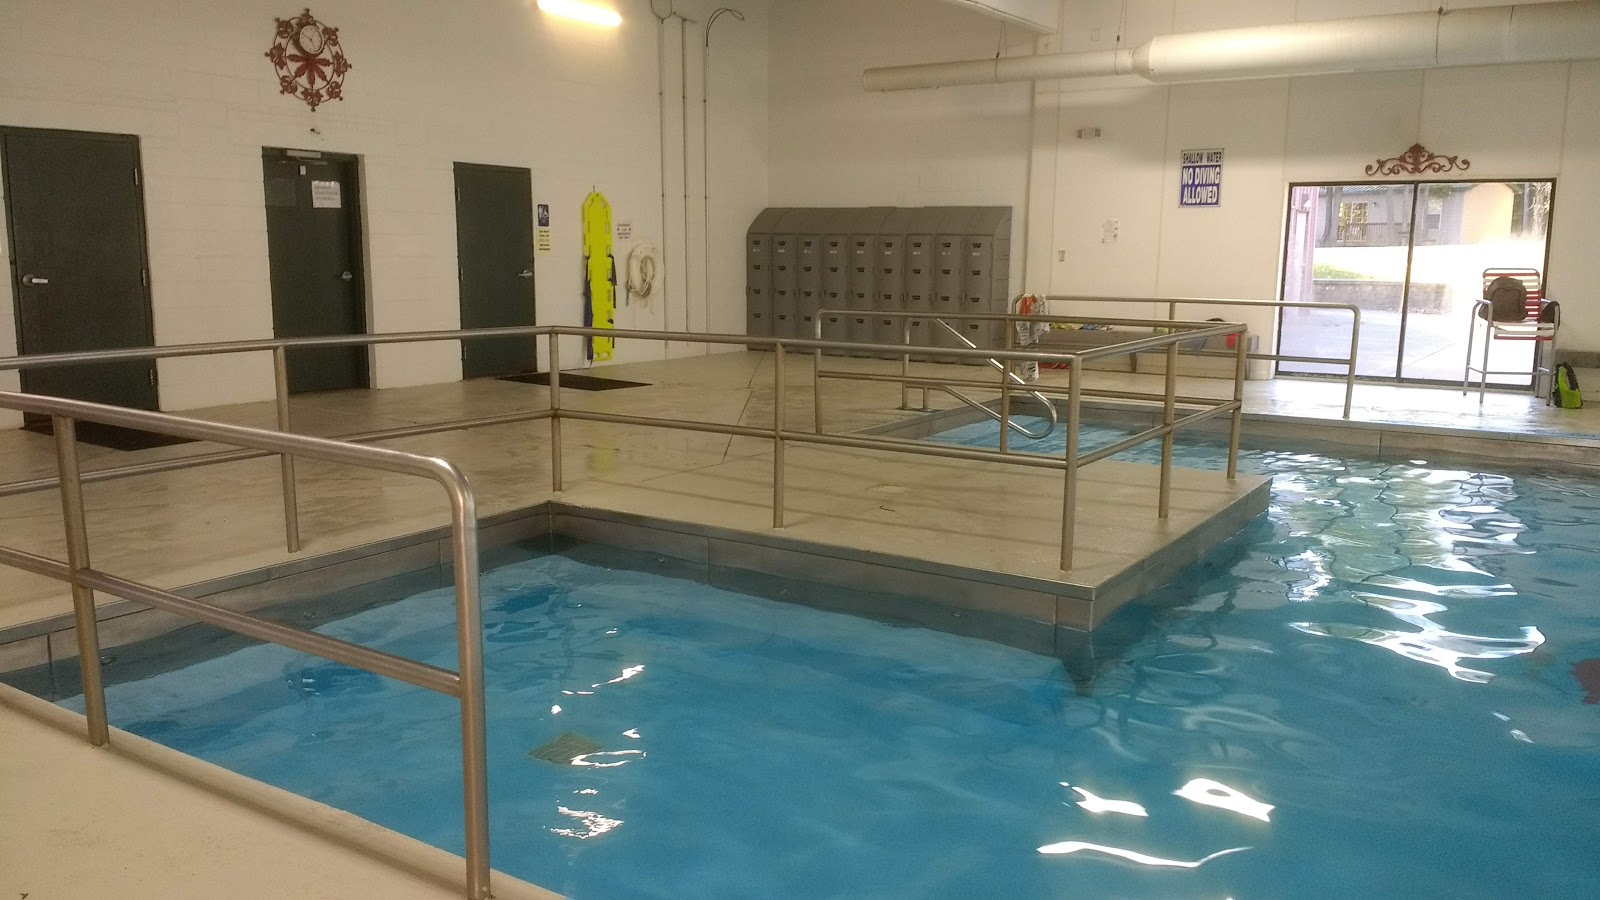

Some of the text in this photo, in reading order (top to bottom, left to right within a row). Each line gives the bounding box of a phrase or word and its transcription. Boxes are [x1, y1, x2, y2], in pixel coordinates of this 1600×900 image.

[1183, 151, 1222, 164] SHALLOW WATER
[1182, 166, 1220, 185] NO DIVING
[1182, 186, 1218, 204] ALLOWED
